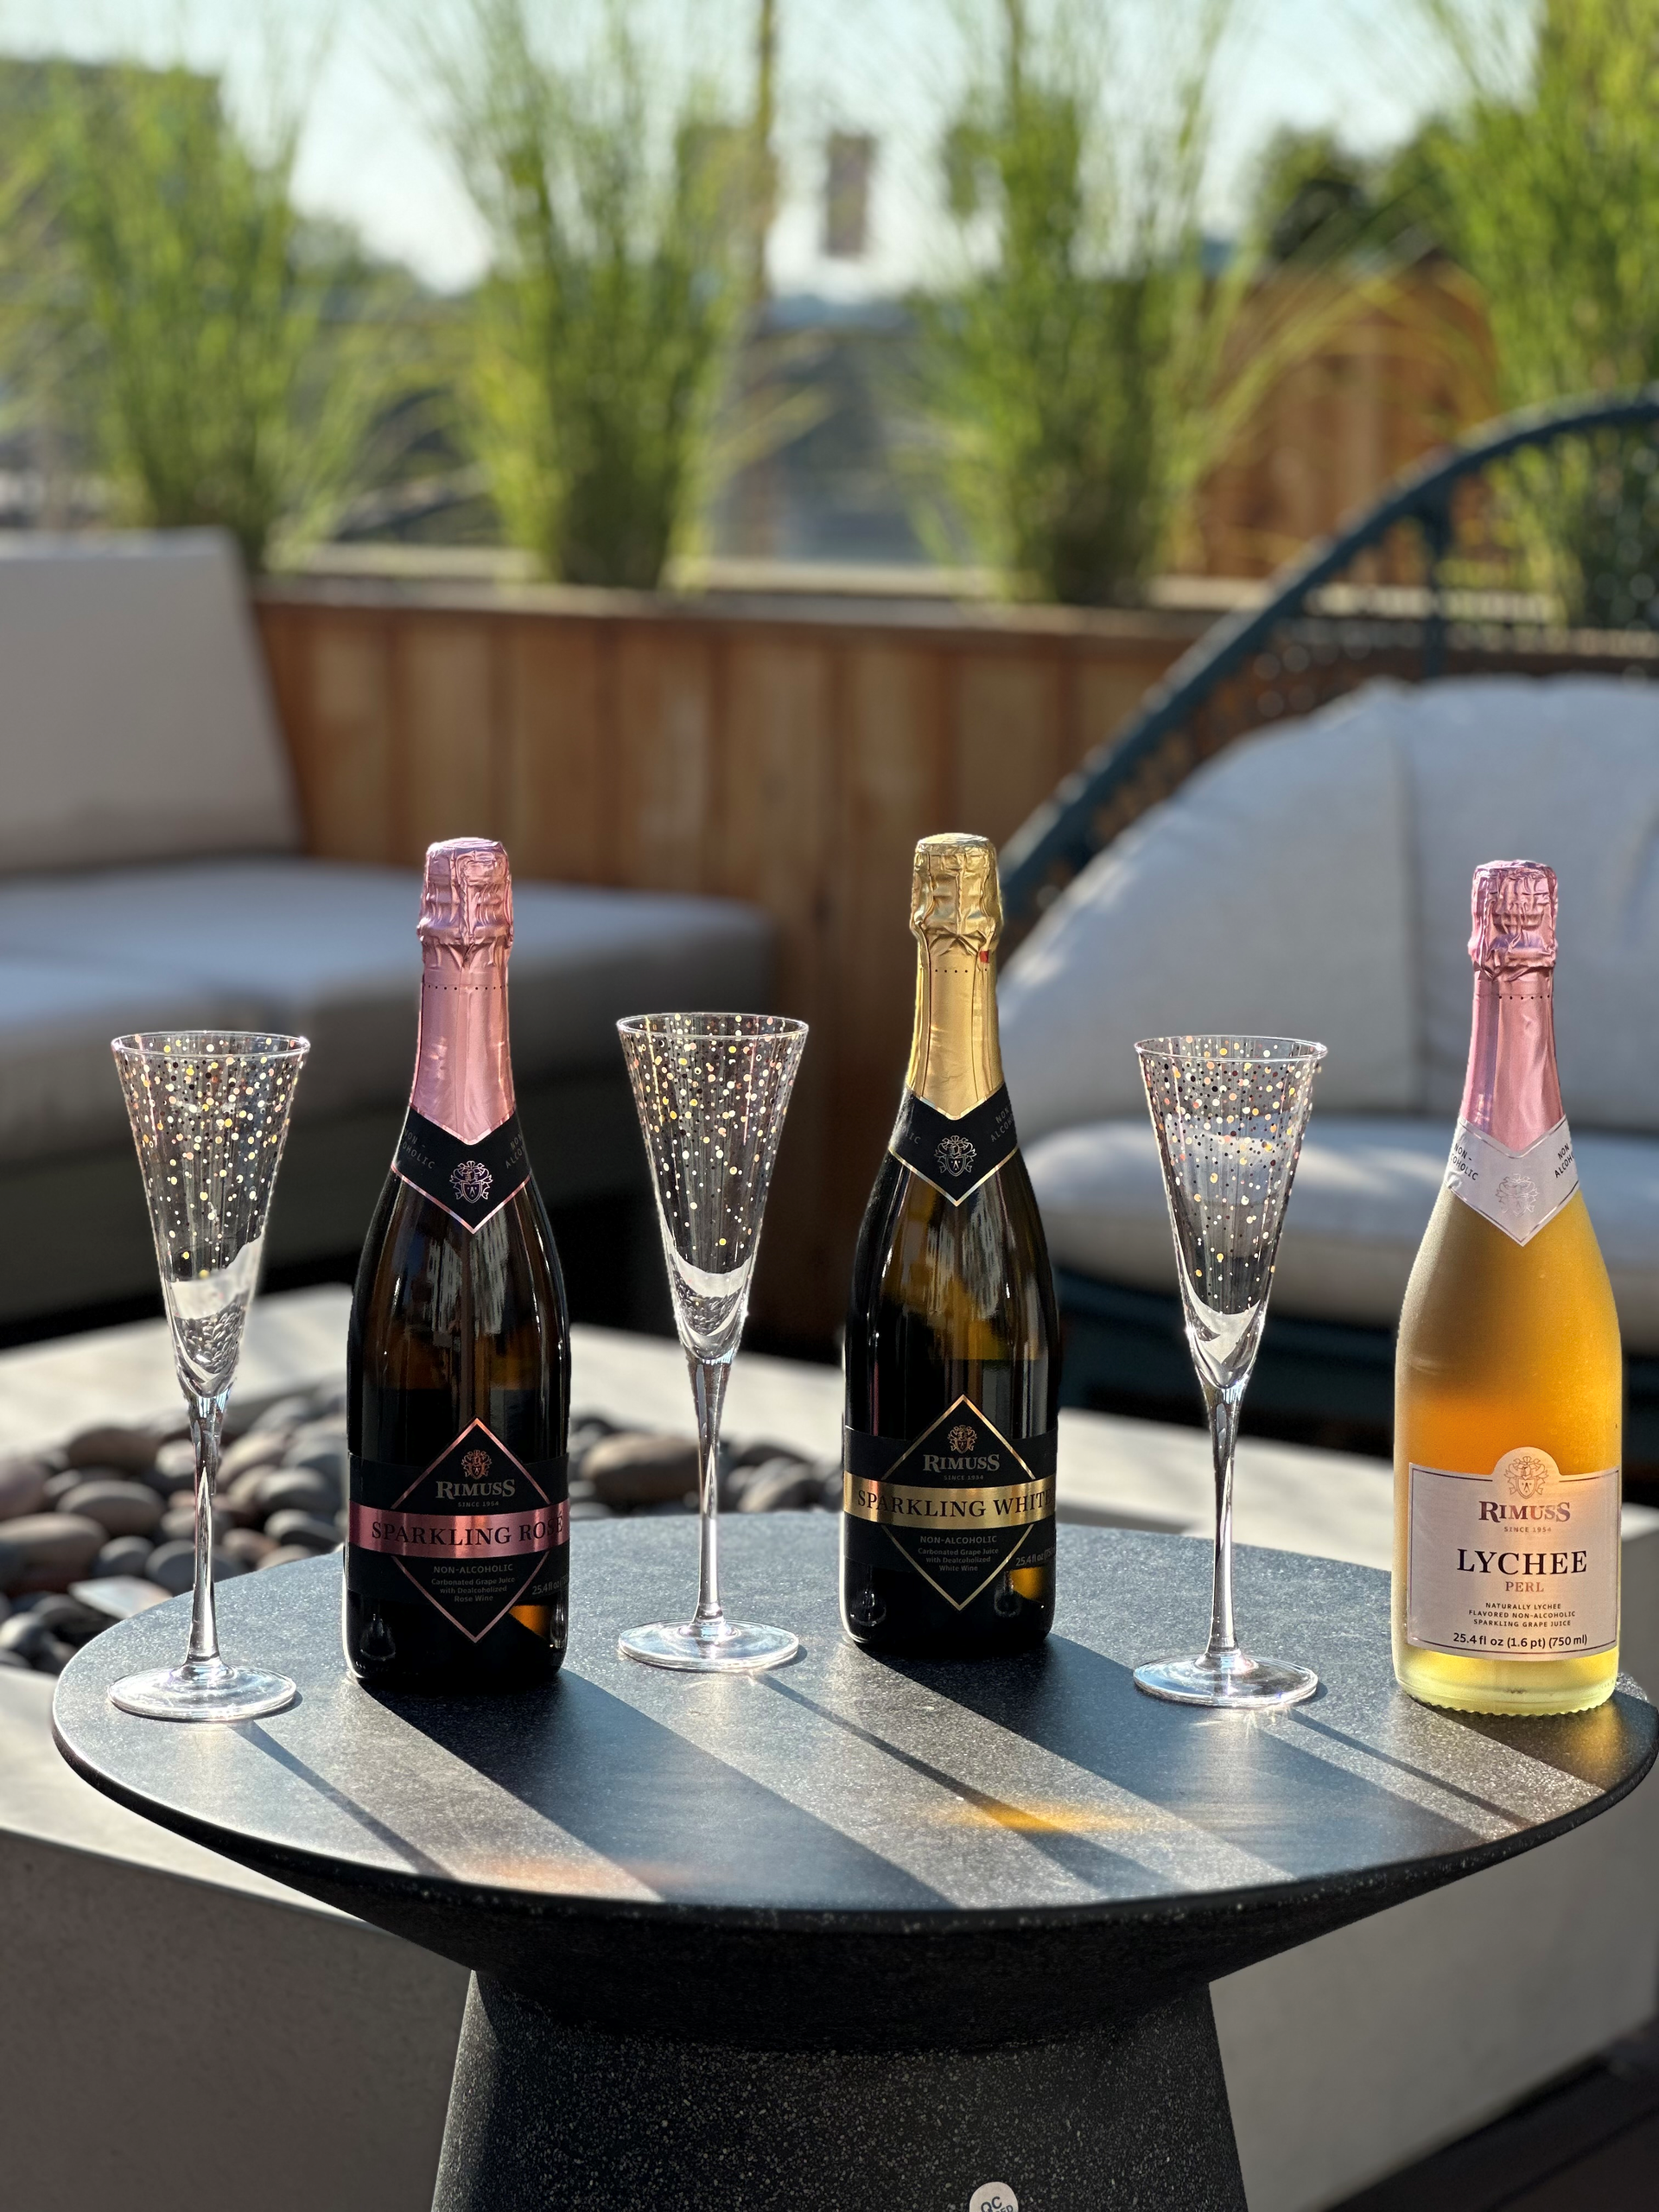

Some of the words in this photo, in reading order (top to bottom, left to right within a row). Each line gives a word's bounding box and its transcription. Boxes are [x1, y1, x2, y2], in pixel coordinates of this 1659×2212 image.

[923, 1453, 1001, 1473] RIMUSS
[435, 1478, 516, 1500] RIMUSS
[857, 1490, 986, 1517] SPARKLING
[994, 1489, 1053, 1516] WHITE
[1478, 1501, 1571, 1523] RIMUSS
[372, 1521, 512, 1546] SPARKLING
[519, 1510, 563, 1541] ROSÉ
[919, 1535, 998, 1545] NON-ALCOHOLIC
[960, 1548, 982, 1556] Grape
[943, 1555, 991, 1564] Dealcoholized
[1457, 1548, 1587, 1575] LYCHEE
[433, 1563, 514, 1574] NON-ALCOHOLIC
[475, 1578, 498, 1586] Grape
[1505, 1581, 1544, 1592] PERL
[457, 1585, 507, 1594] Dealcoholized
[1469, 1610, 1510, 1618] FLAVORED
[1473, 1618, 1519, 1627] SPARKLING
[1453, 1632, 1478, 1644] 25.4
[1479, 1634, 1487, 1645] fl
[1490, 1637, 1504, 1647] oz
[1507, 1637, 1527, 1649] (1.6
[1530, 1636, 1546, 1649] pt)
[1548, 1636, 1572, 1649] (750
[1573, 1634, 1588, 1647] ml)
